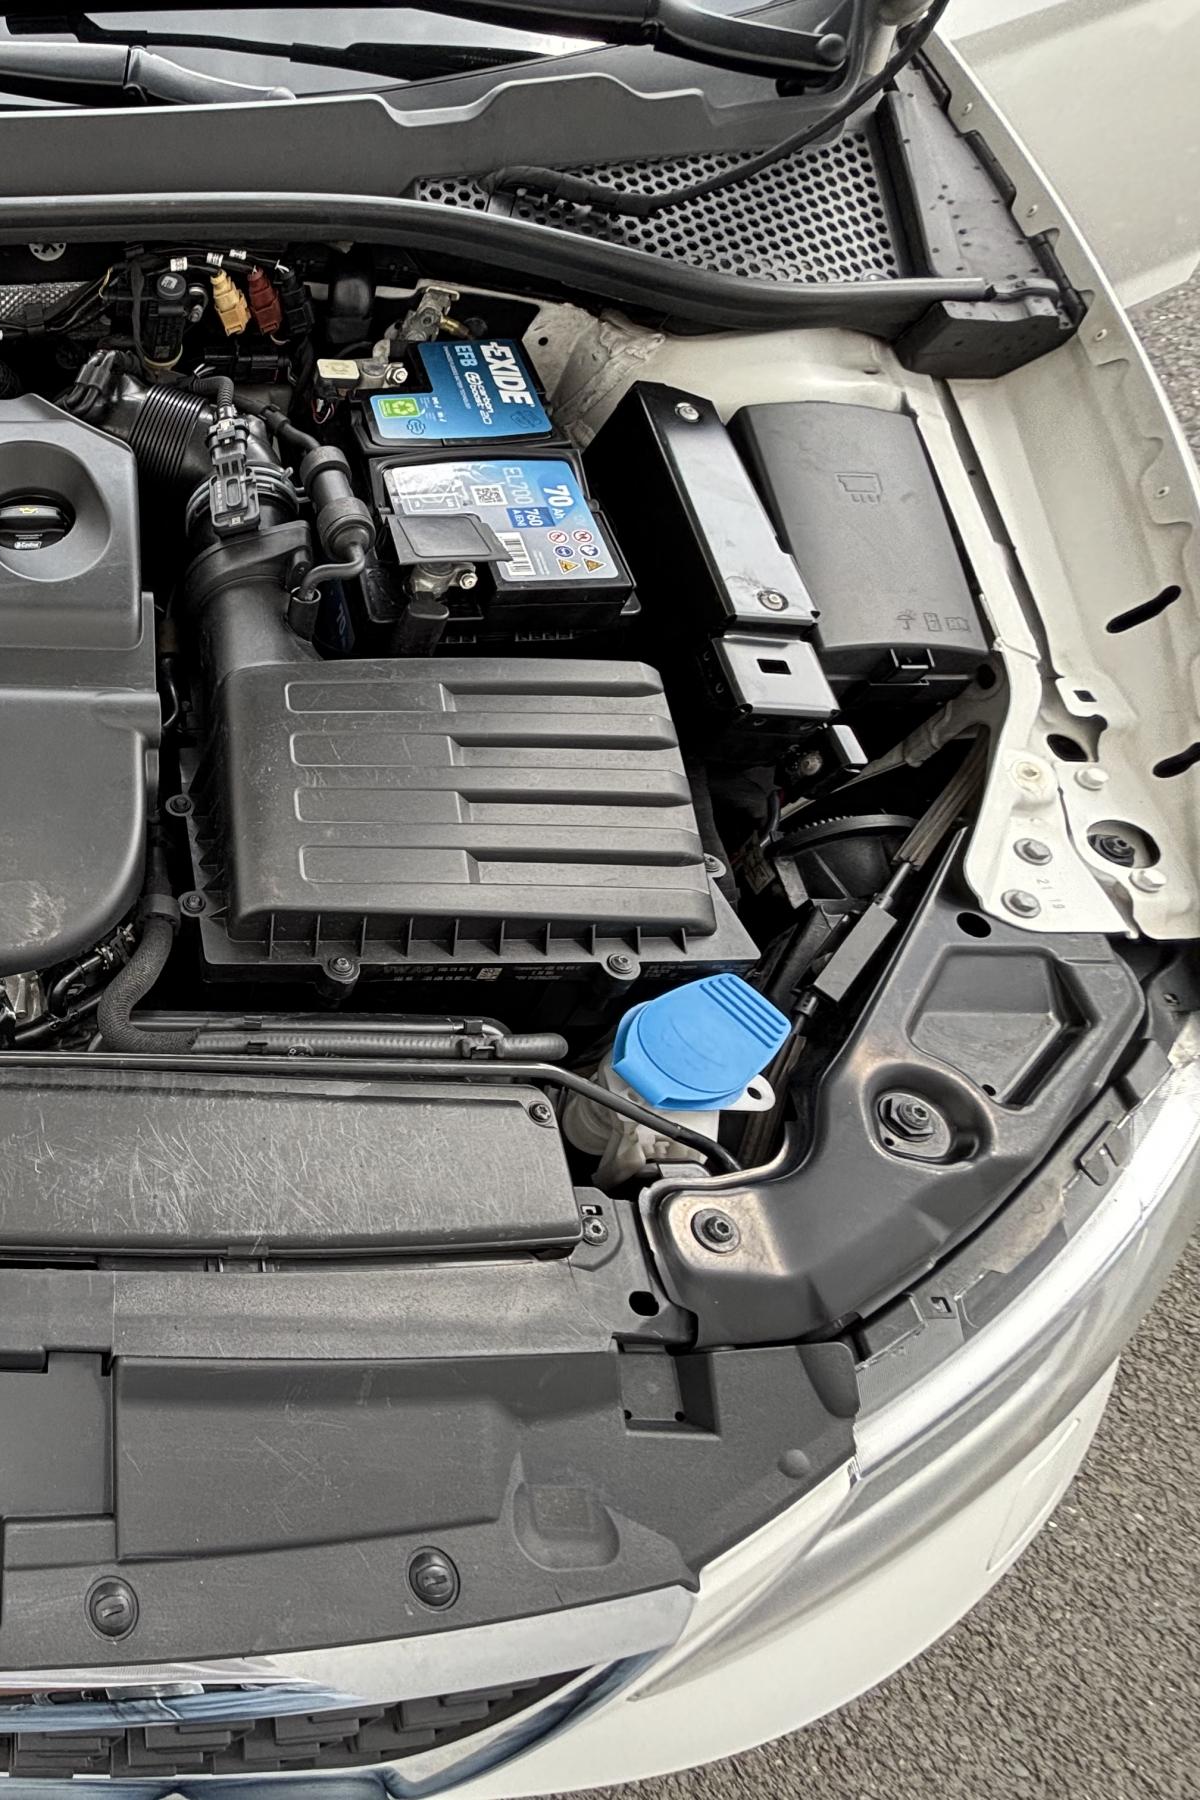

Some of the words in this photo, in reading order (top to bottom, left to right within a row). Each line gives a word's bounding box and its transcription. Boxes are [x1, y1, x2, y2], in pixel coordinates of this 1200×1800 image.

[455, 345, 478, 367] EFB
[480, 341, 534, 405] EXIDE
[469, 385, 484, 409] boost
[478, 384, 494, 413] carbon
[502, 466, 534, 504] EL700
[543, 485, 574, 507] 70
[524, 509, 544, 526] 760
[552, 508, 566, 519] Ah
